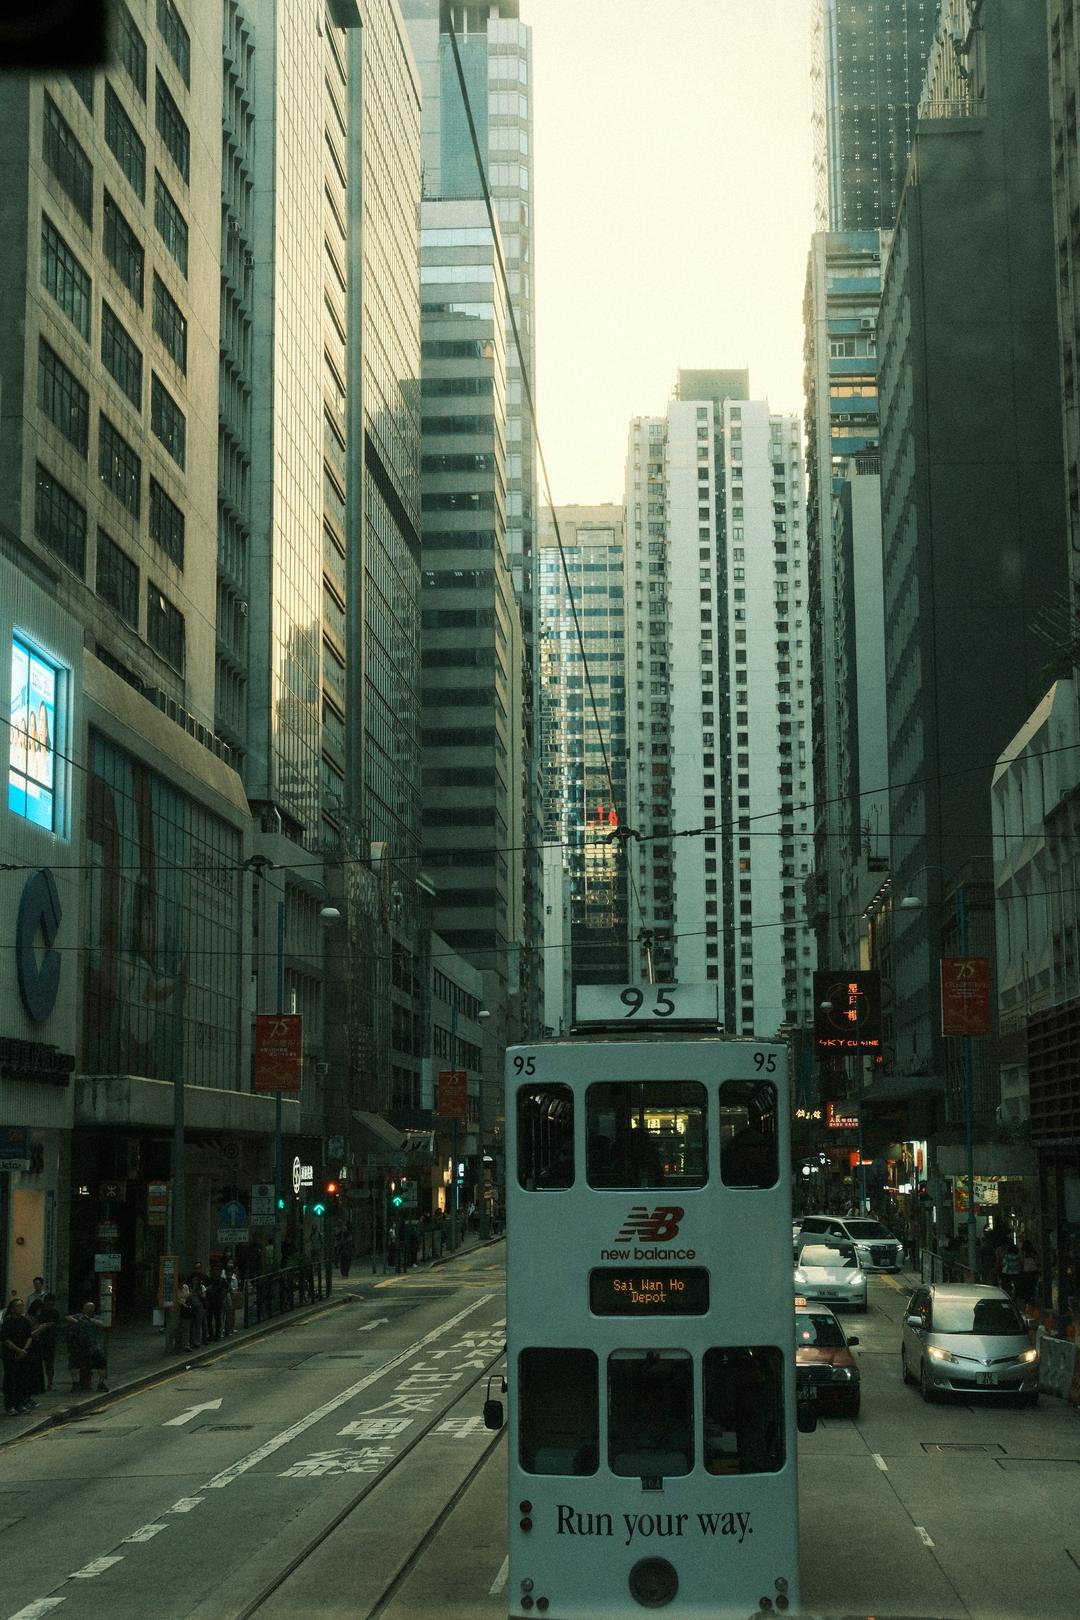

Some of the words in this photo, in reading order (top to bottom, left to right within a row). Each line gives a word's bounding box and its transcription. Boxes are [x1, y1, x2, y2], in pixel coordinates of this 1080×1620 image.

[953, 961, 977, 980] 75
[620, 987, 677, 1018] 95
[268, 1018, 289, 1039] 75
[847, 1039, 880, 1047] CUSINE
[513, 1056, 536, 1075] 95
[753, 1052, 778, 1073] 95
[600, 1249, 631, 1260] new
[634, 1247, 696, 1260] balance
[613, 1279, 634, 1291] Sai
[641, 1279, 664, 1291] Wan
[670, 1279, 685, 1291] Ho
[631, 1291, 667, 1304] Depot
[450, 1338, 507, 1348] AN
[556, 1504, 614, 1536] Run
[623, 1513, 688, 1546] your
[696, 1511, 753, 1544] way.
